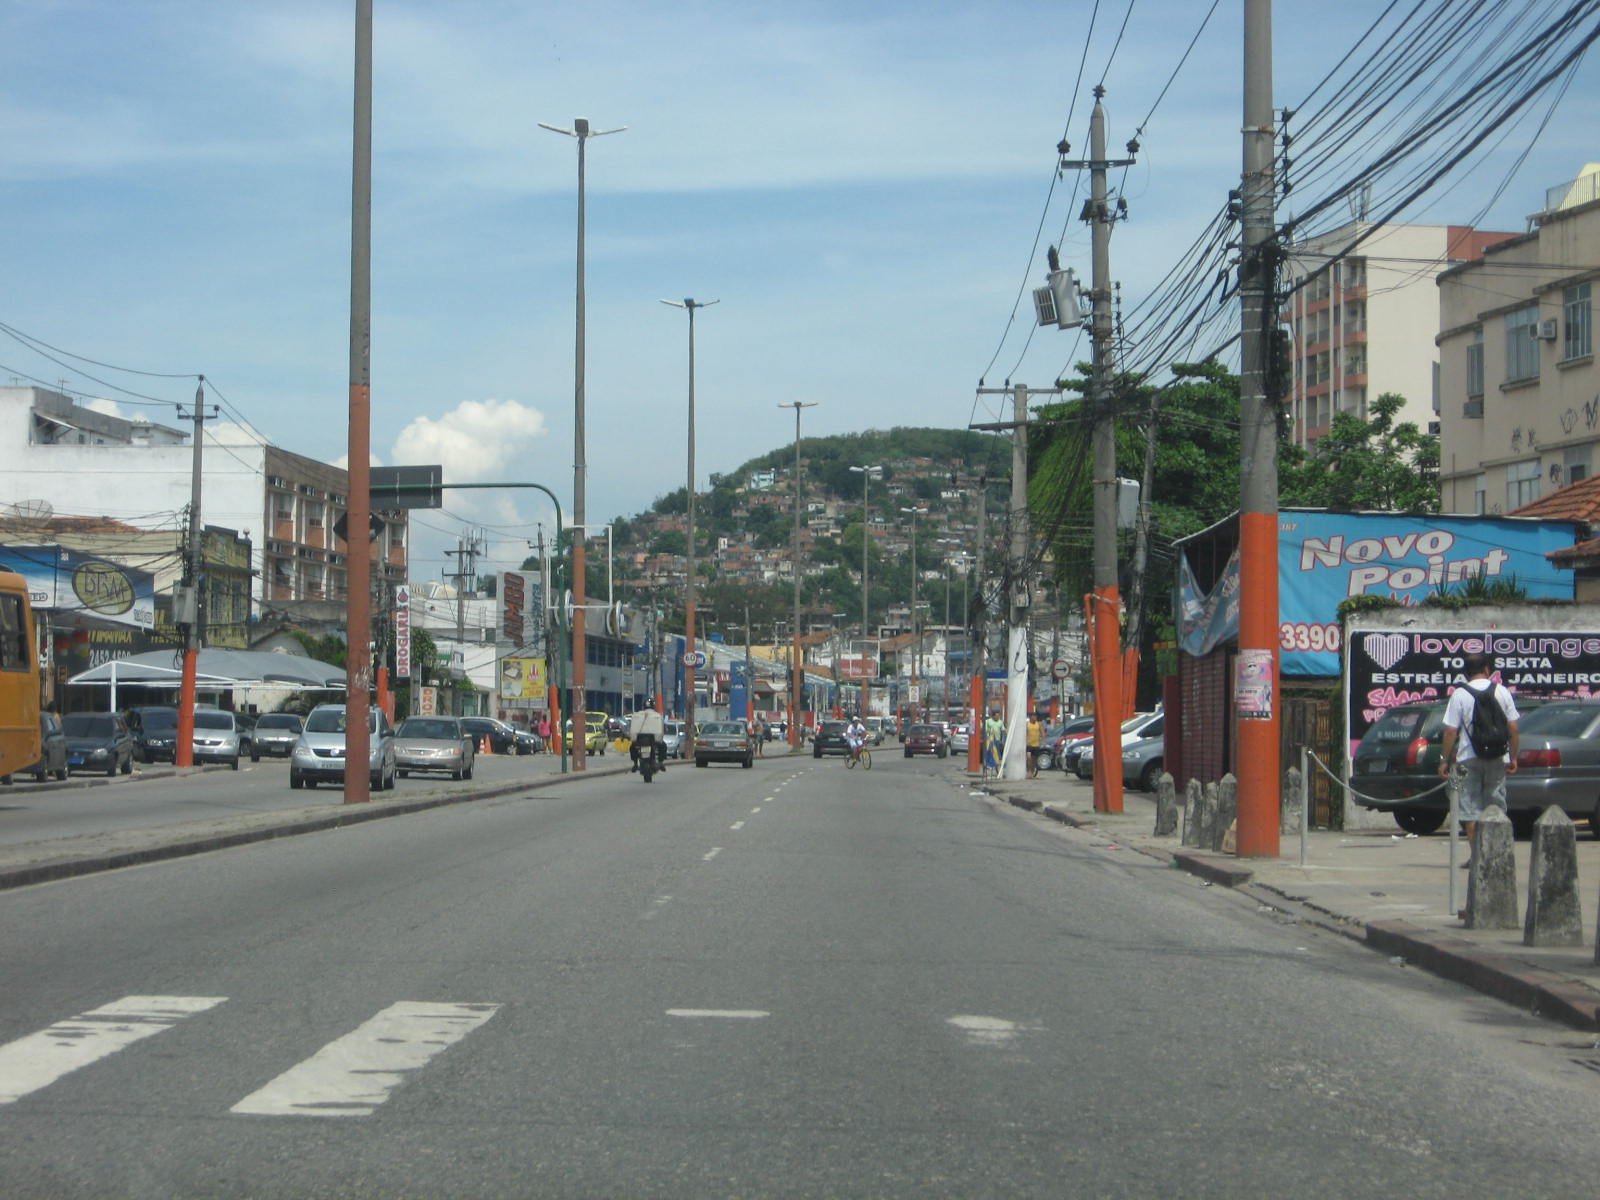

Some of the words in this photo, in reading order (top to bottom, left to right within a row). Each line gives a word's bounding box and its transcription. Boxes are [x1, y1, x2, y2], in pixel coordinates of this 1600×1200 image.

[1300, 530, 1455, 571] Novo
[1348, 549, 1509, 597] Point
[1371, 670, 1469, 684] ESTRÉIA
[1494, 658, 1552, 669] SEXTA
